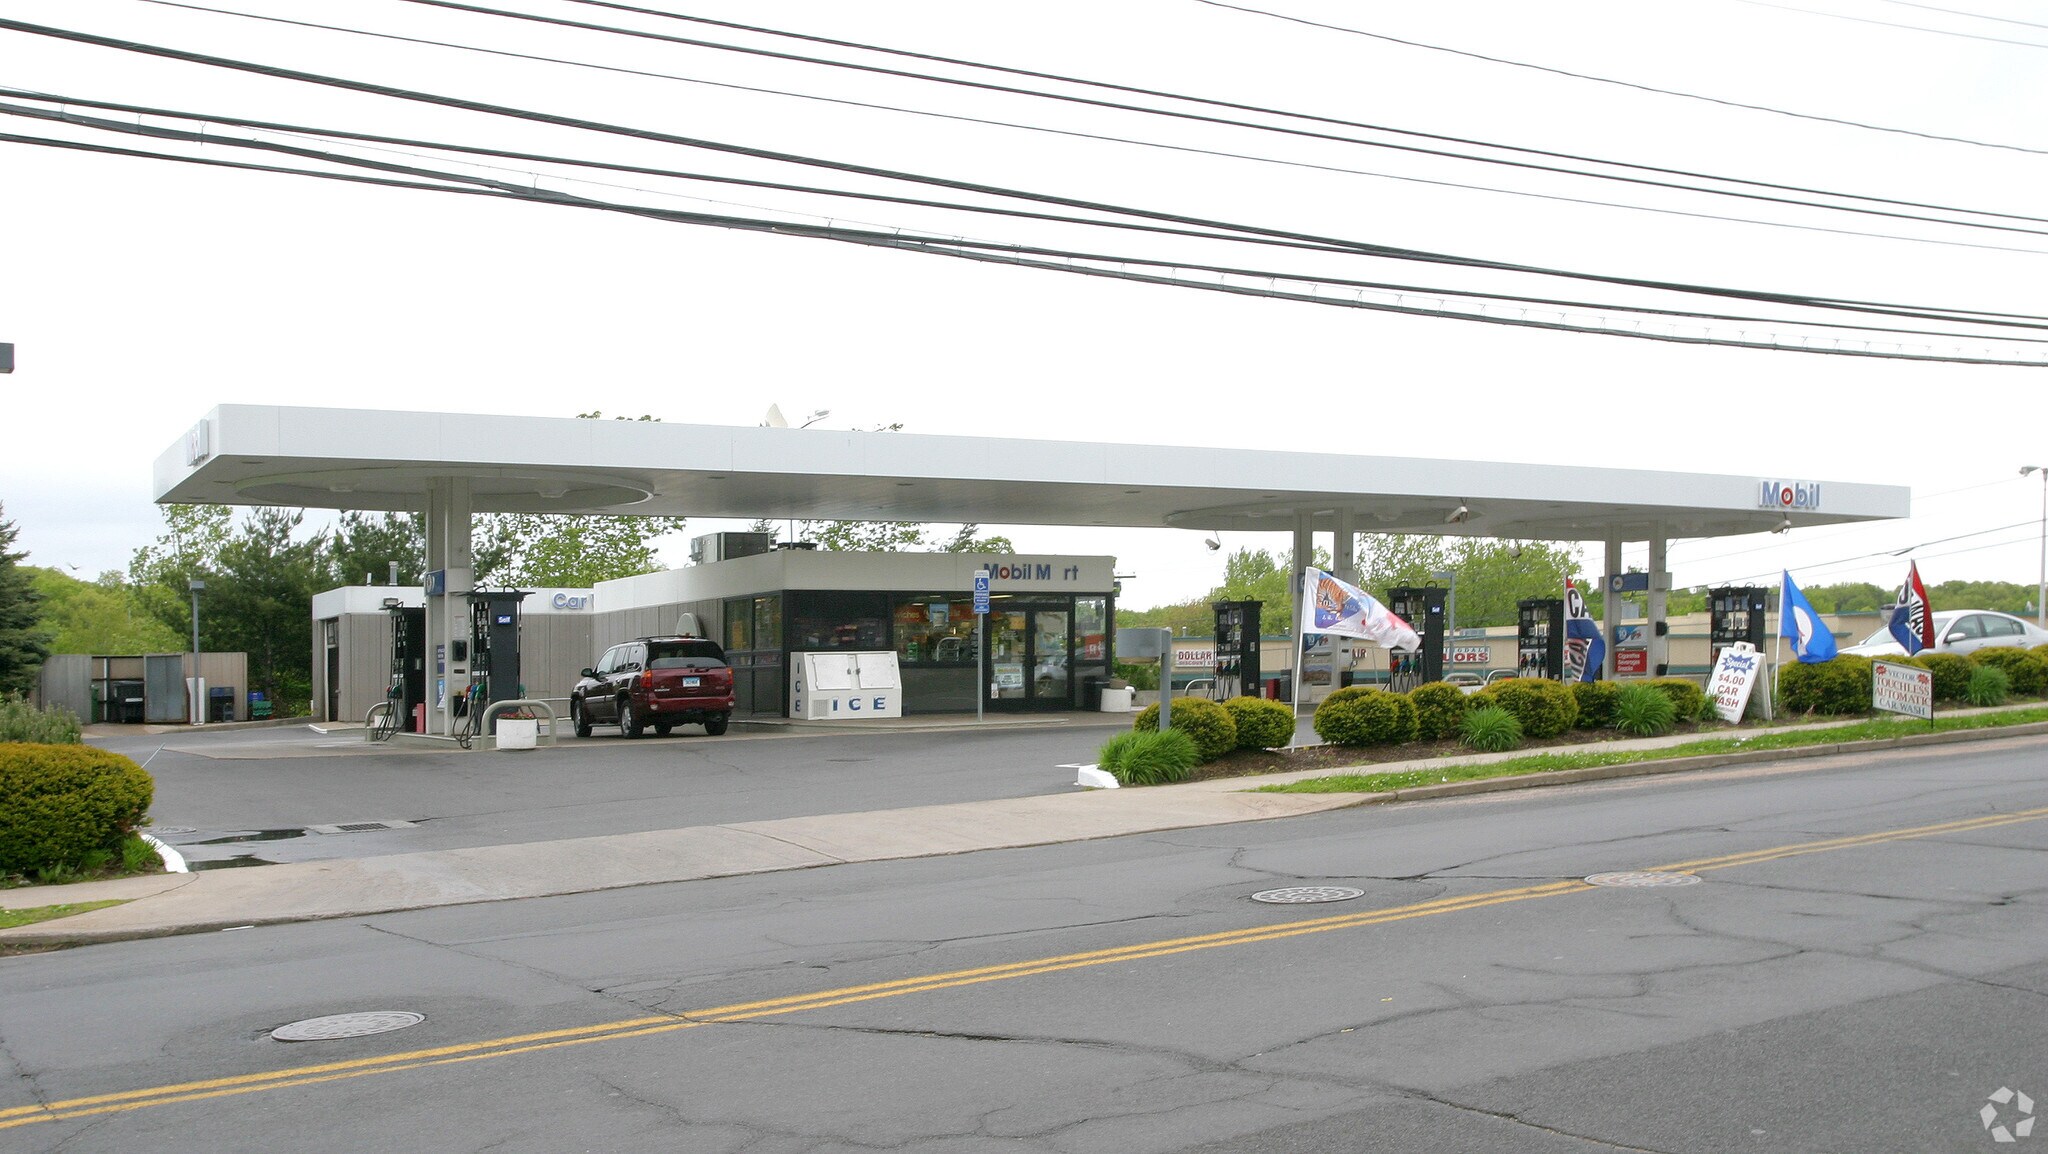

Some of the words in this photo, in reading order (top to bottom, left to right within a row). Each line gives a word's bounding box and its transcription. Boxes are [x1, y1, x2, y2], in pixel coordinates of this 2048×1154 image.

[1762, 481, 1820, 507] Mobil
[983, 563, 1031, 580] Mobil
[553, 593, 587, 609] Car
[1178, 651, 1212, 660] DOLLAR
[1726, 656, 1750, 668] Special
[1718, 674, 1745, 685] $4.00
[1888, 670, 1916, 681] VECTOR
[1717, 685, 1739, 696] CAR
[1876, 677, 1930, 696] TOUCHLESS
[1875, 687, 1931, 705] AUTOMATIC
[833, 697, 886, 711] ICE
[1880, 698, 1898, 709] CAR
[1900, 703, 1925, 715] WASH
